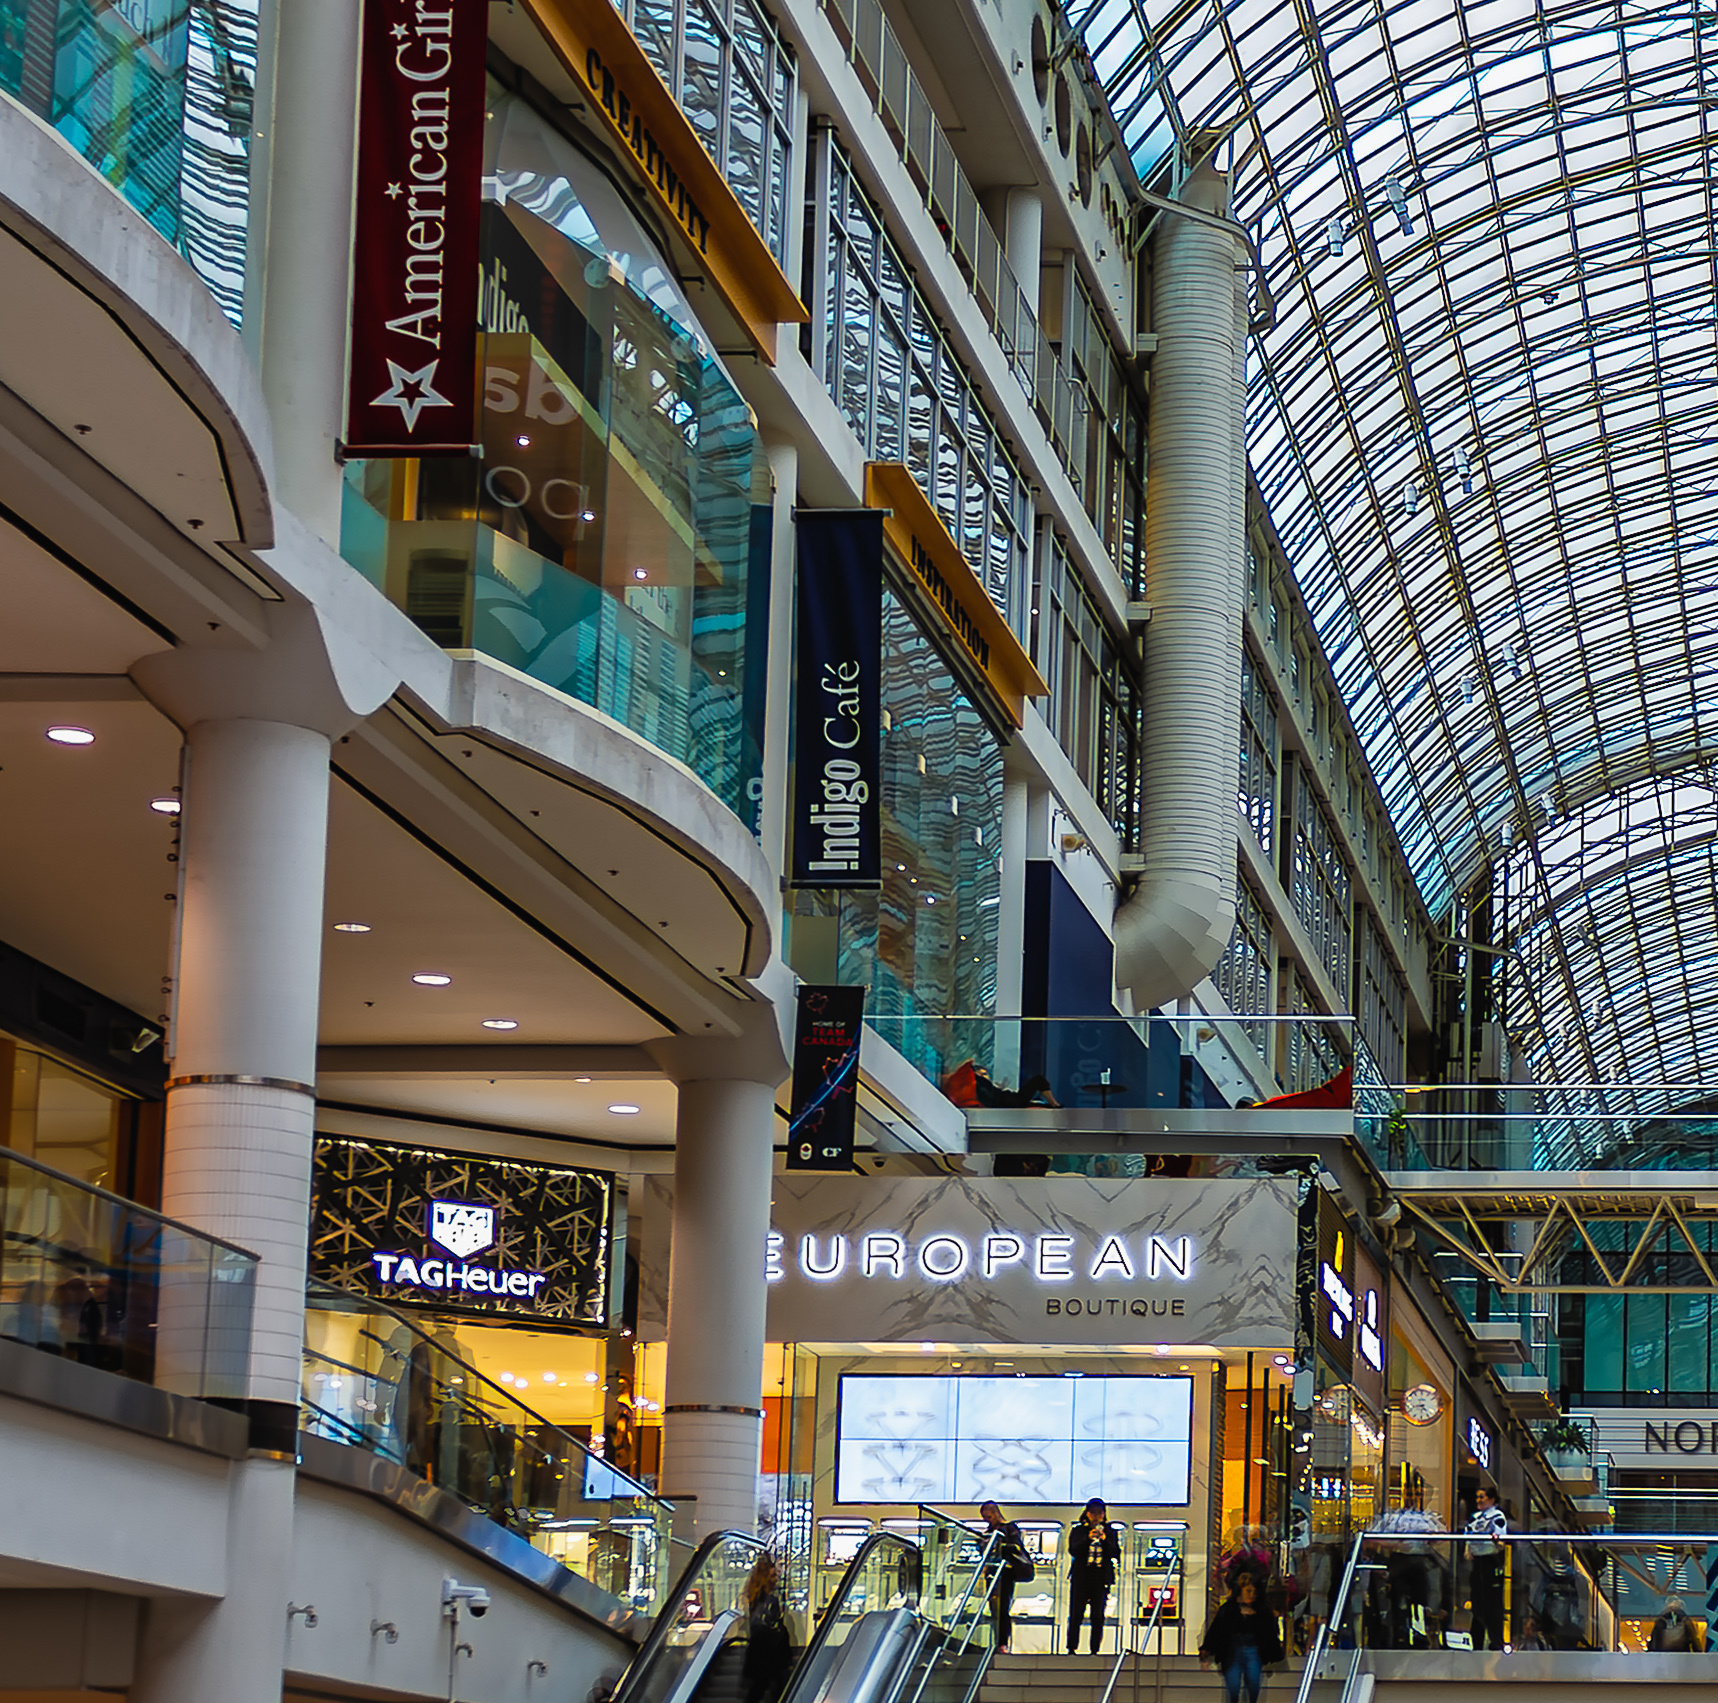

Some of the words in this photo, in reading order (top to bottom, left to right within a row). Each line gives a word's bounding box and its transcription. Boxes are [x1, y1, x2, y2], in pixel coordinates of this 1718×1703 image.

[586, 46, 711, 256] CREATIVITY
[911, 534, 990, 671] INSPIRATION
[821, 659, 860, 750] Café
[808, 759, 869, 871] Indigo
[802, 1036, 854, 1047] CANADA
[812, 1027, 845, 1037] TEAM
[766, 1234, 1191, 1281] UROPEAN
[1045, 1298, 1187, 1317] BOUTIQUE
